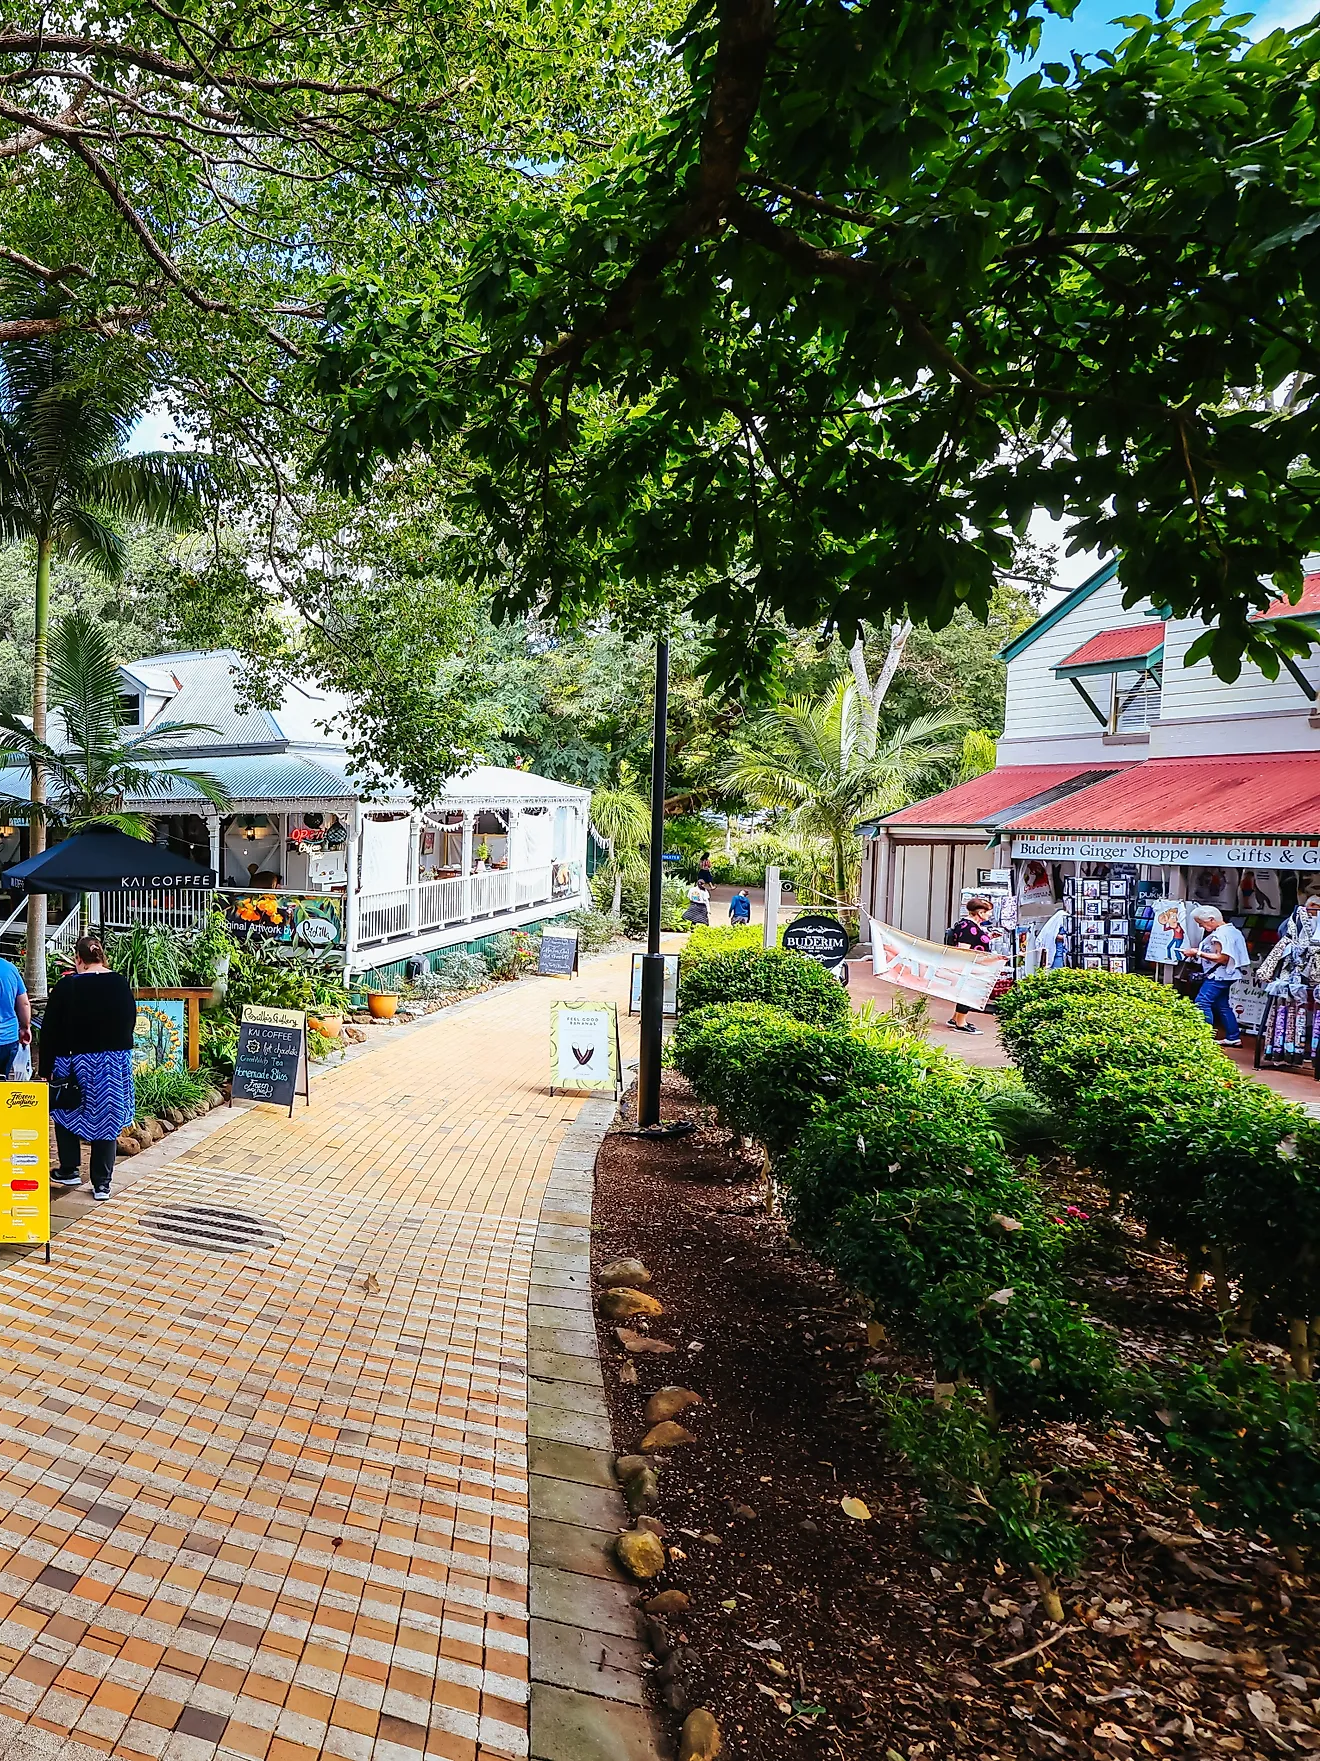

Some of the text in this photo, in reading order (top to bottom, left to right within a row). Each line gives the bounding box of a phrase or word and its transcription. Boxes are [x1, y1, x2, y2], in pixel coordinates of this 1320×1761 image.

[1020, 842, 1075, 856] Buderim
[1080, 844, 1127, 860] Ginger
[1133, 844, 1189, 862] Shoppe
[1227, 848, 1272, 862] Gifts
[1279, 849, 1295, 864] &
[1302, 849, 1320, 864] G
[121, 875, 210, 888] KAI COFFEE
[249, 922, 282, 935] Artwork
[283, 925, 294, 937] by
[787, 937, 844, 948] BUDERIM
[248, 1028, 293, 1042] KAI COFFEE
[271, 1057, 284, 1067] Tea
[235, 1066, 270, 1080] Homemade
